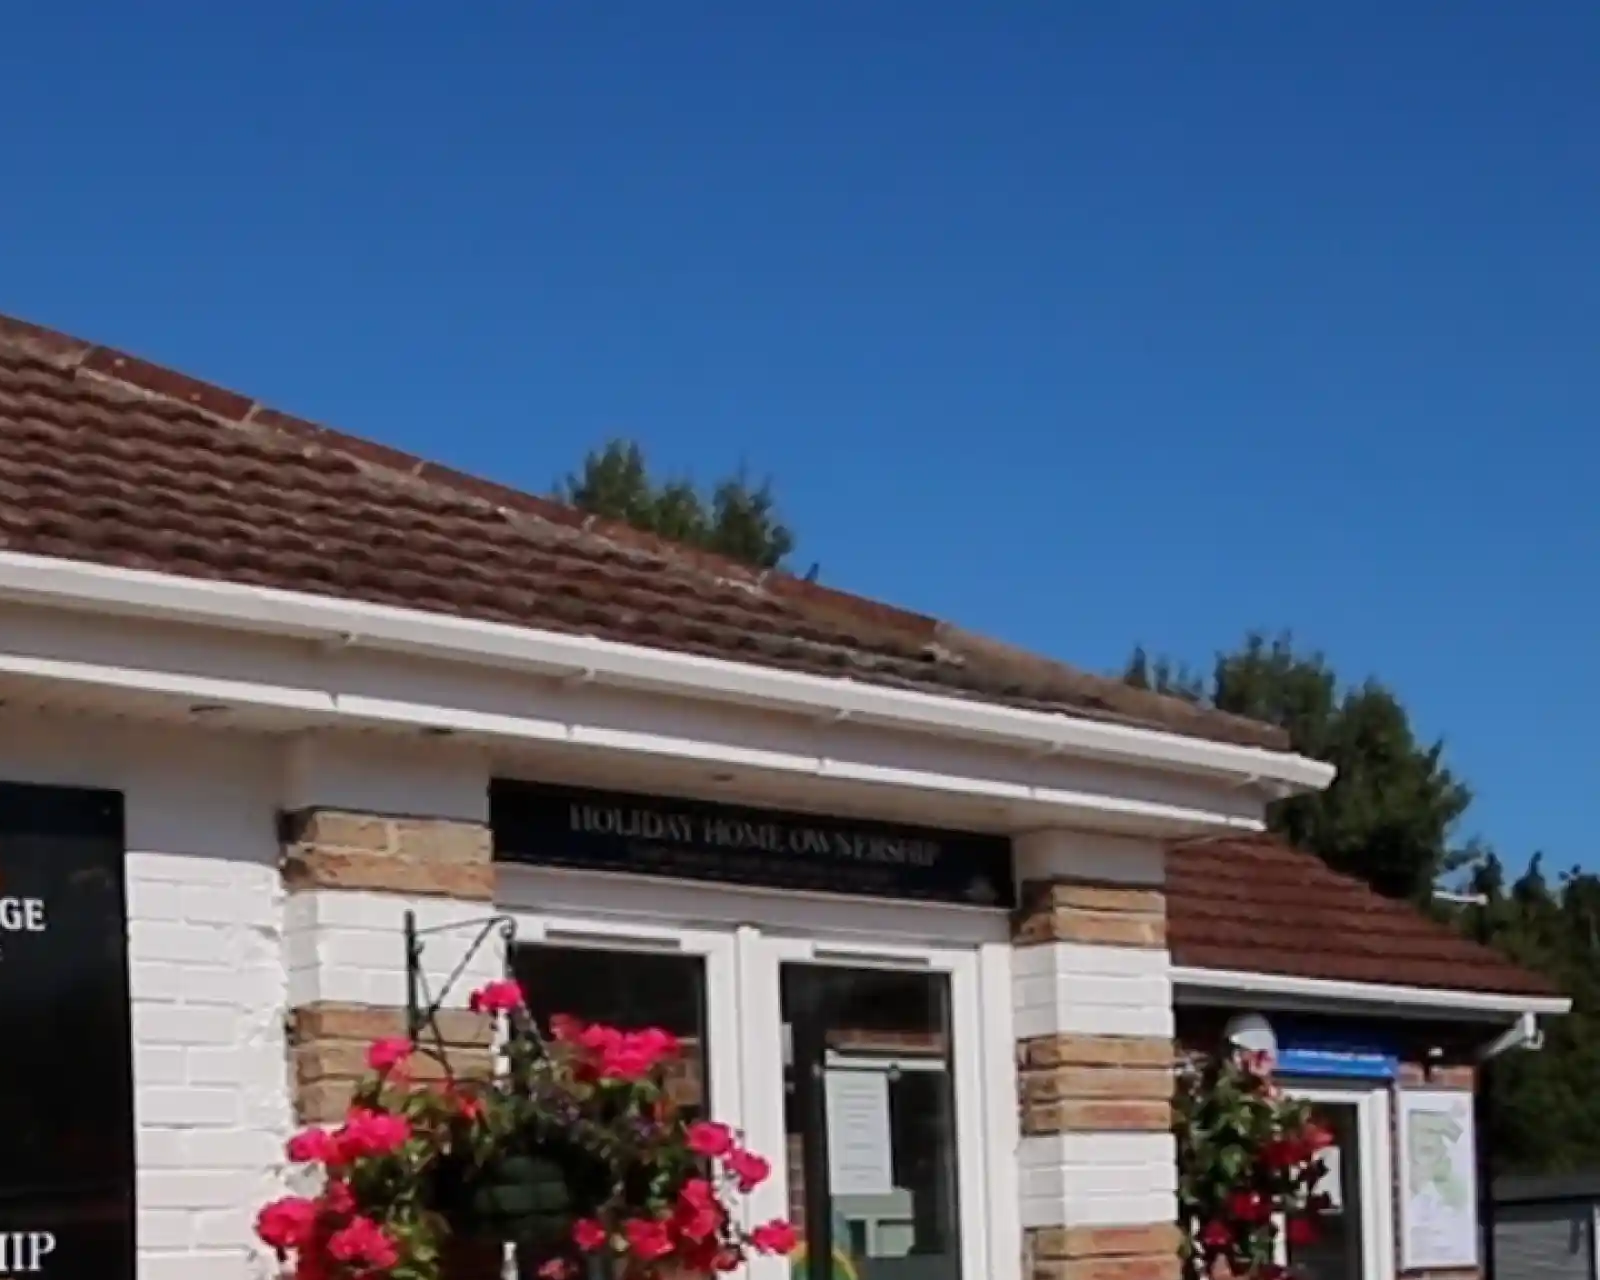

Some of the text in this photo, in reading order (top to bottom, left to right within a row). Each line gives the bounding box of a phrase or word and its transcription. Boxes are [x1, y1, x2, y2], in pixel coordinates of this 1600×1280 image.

[569, 803, 694, 844] HOLIDAY
[703, 817, 786, 855] HOME
[790, 827, 941, 868] OWNERSHIP
